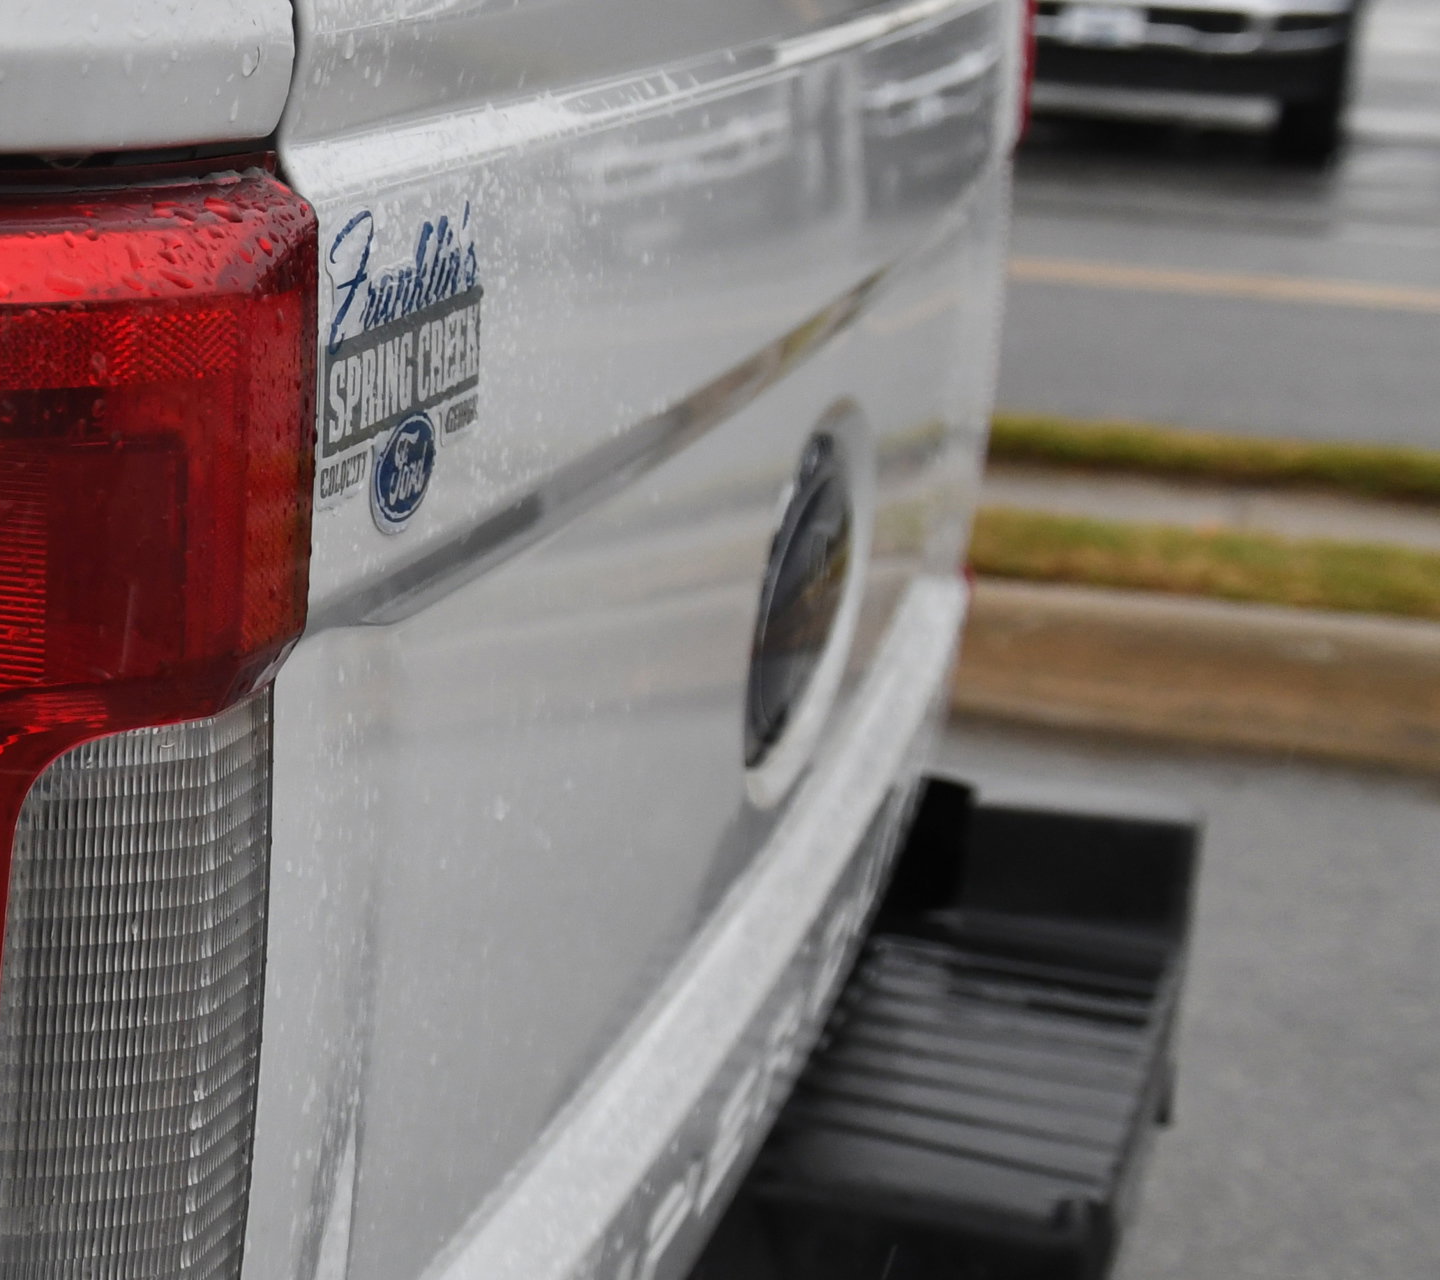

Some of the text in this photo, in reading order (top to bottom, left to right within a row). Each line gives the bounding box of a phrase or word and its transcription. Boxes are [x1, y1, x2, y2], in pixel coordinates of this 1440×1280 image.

[329, 200, 478, 355] Franklin's
[328, 303, 480, 445] SPRING CREEK
